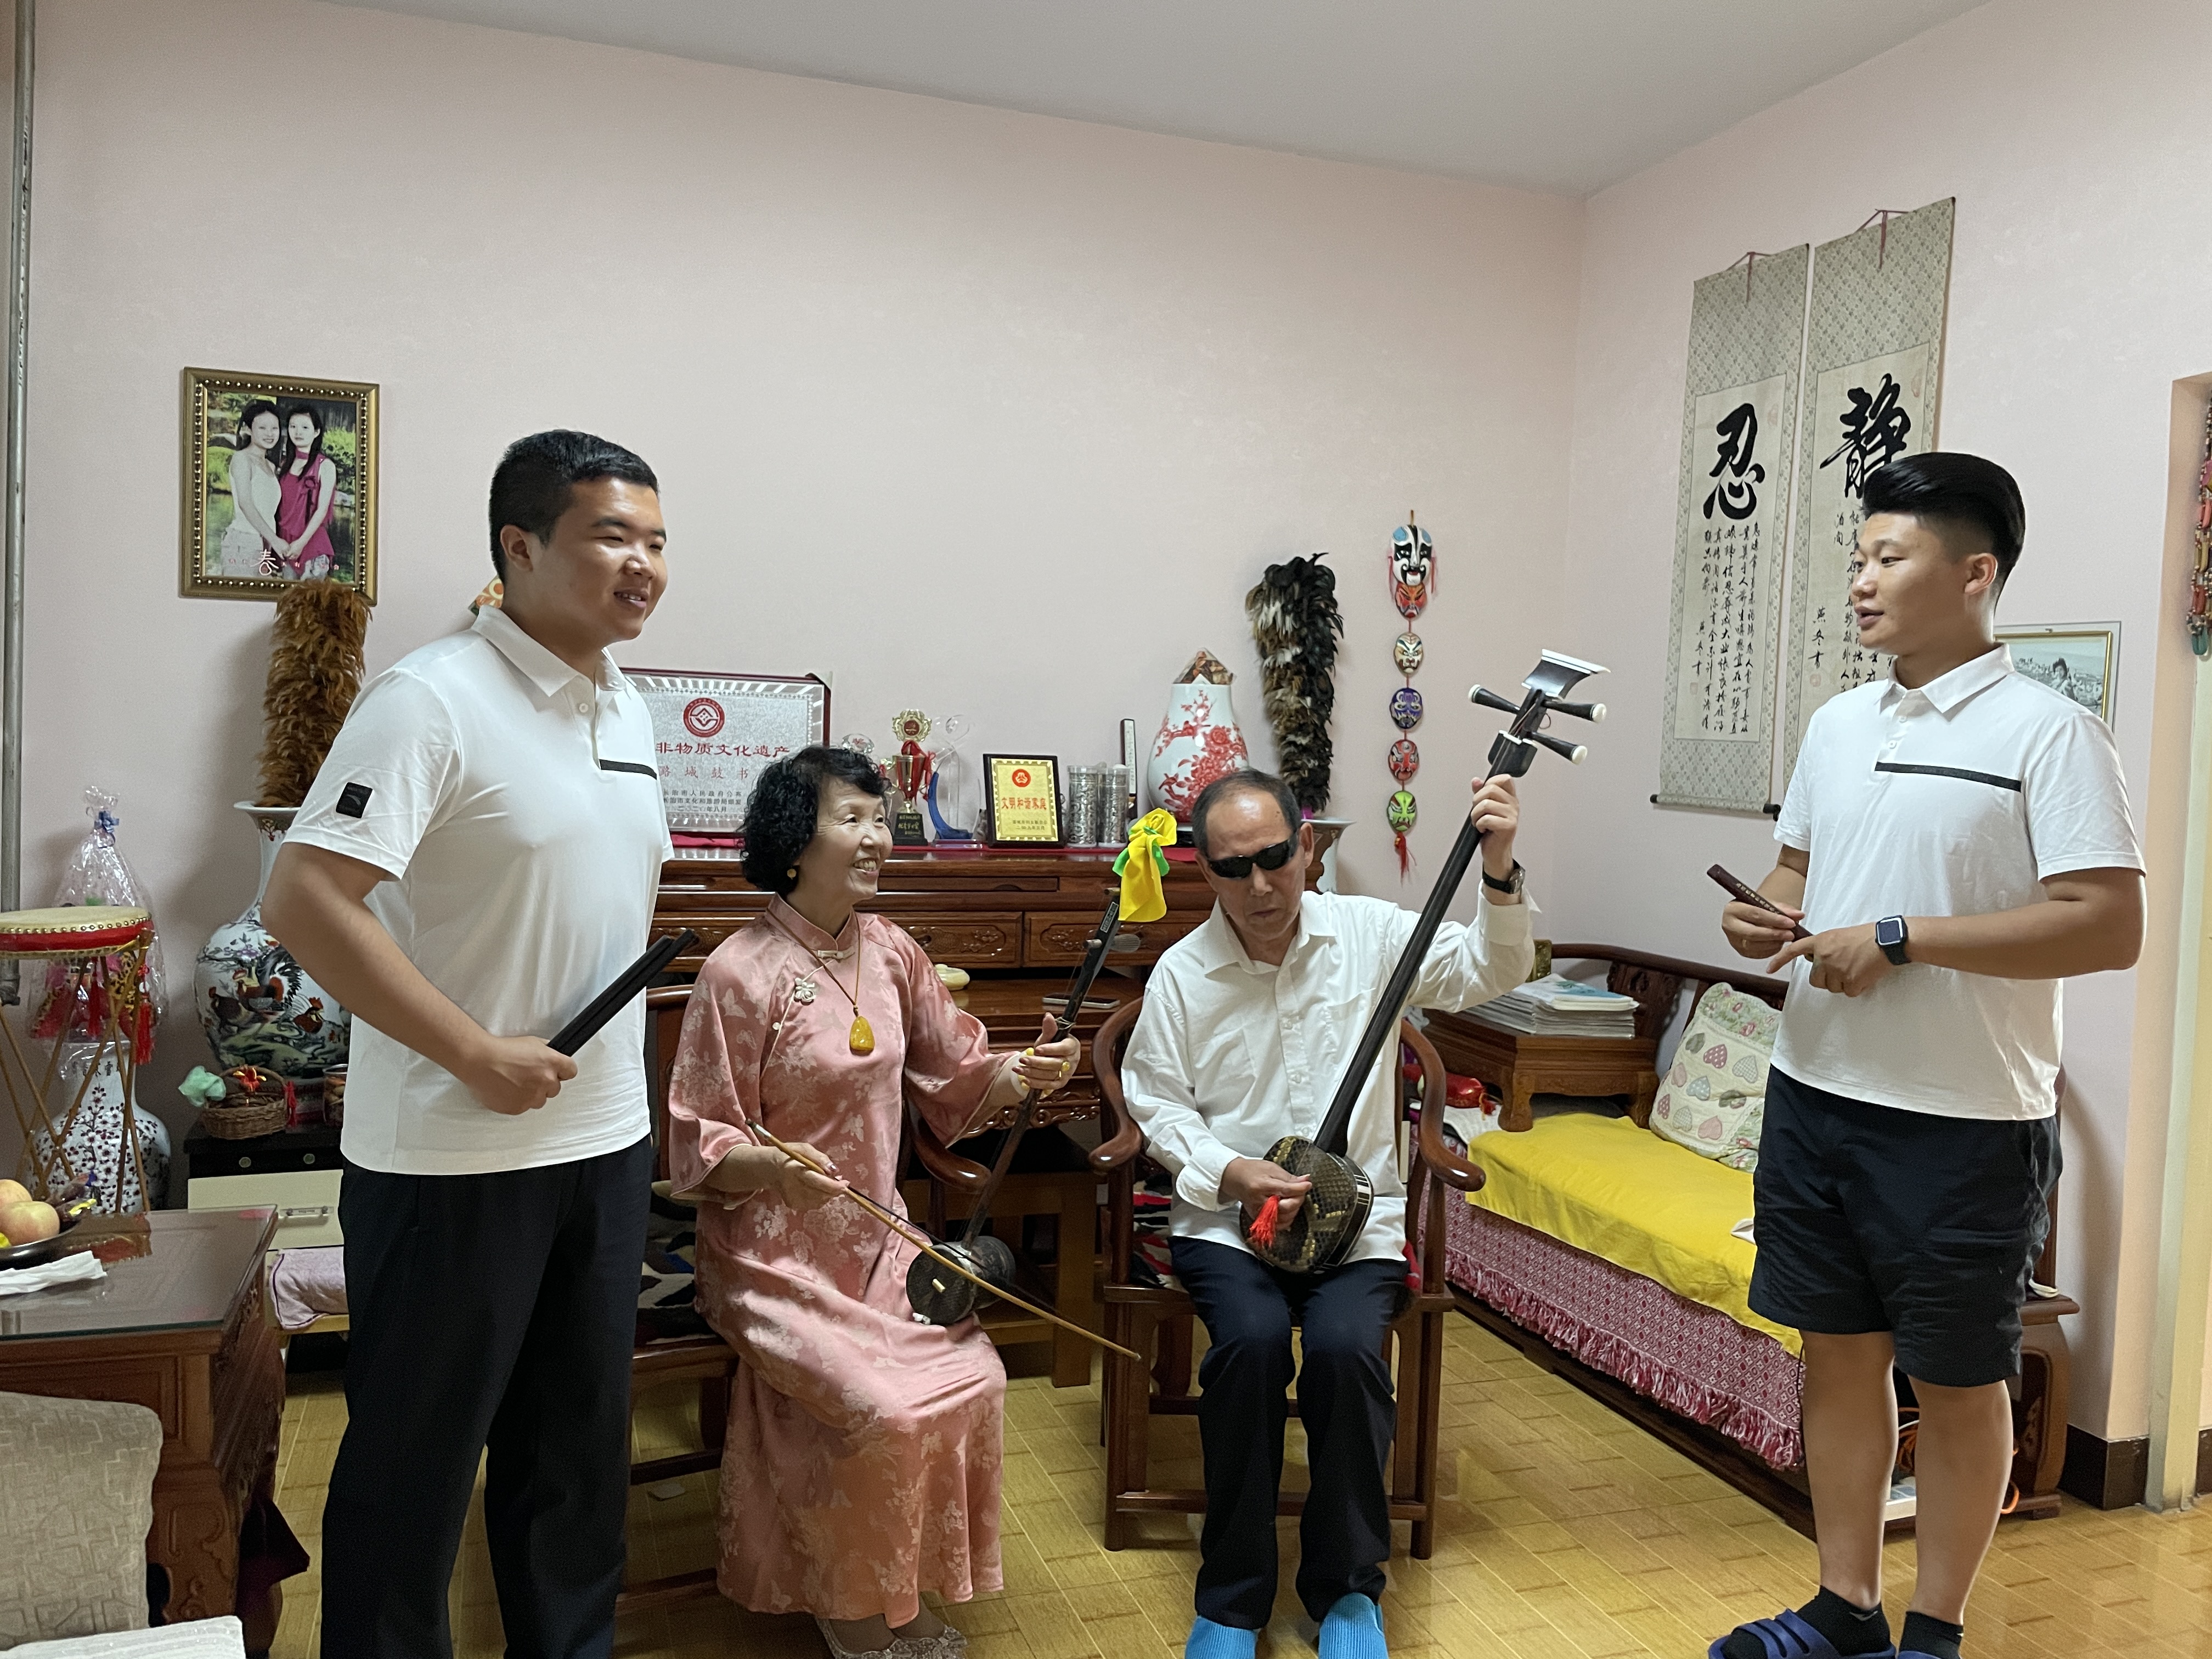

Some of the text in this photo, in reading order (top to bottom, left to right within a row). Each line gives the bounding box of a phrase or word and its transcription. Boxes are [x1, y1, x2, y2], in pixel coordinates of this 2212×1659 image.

[1703, 403, 1765, 520] 忍
[250, 549, 279, 575] 春
[656, 742, 790, 758] 非物质文化遗产
[1001, 797, 1046, 810] 文明和谐家庭
